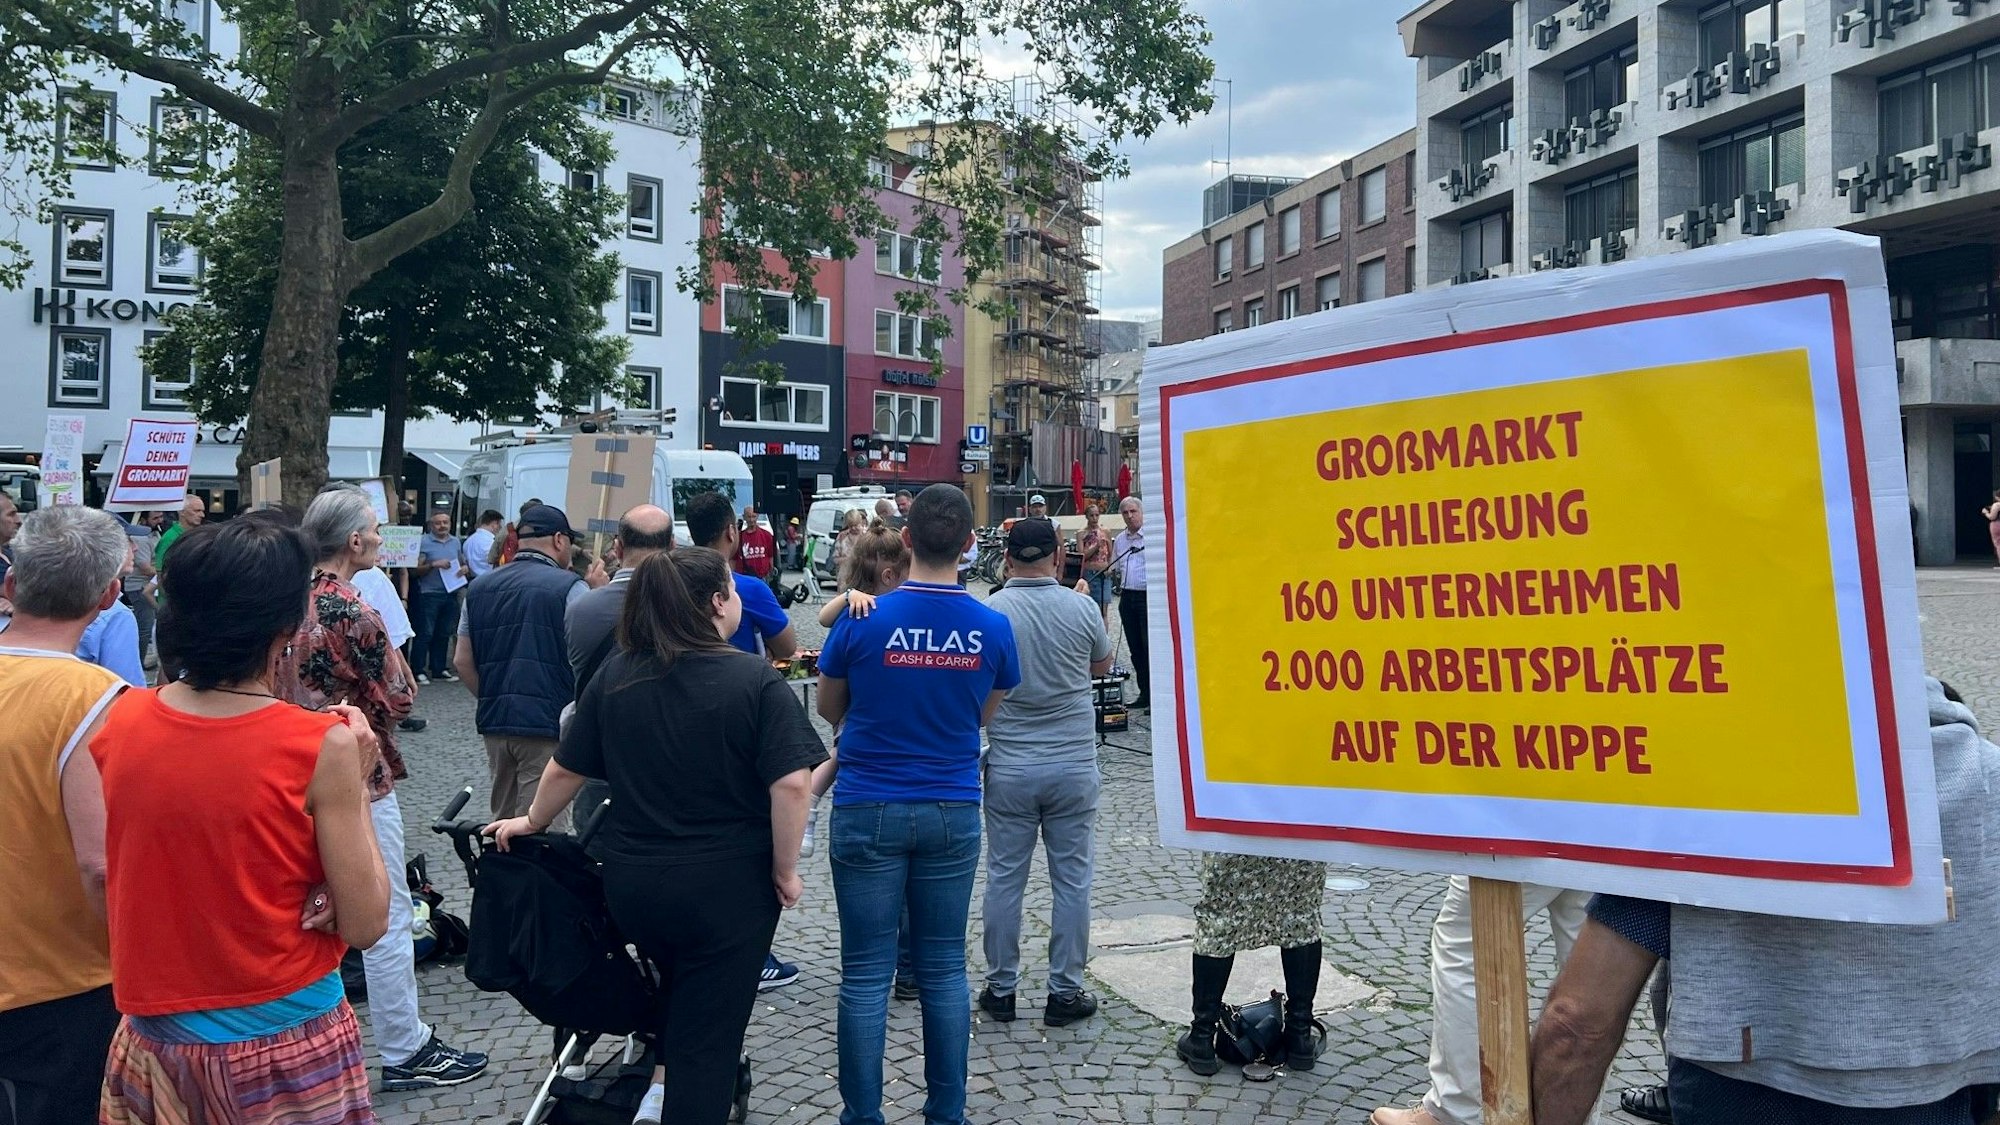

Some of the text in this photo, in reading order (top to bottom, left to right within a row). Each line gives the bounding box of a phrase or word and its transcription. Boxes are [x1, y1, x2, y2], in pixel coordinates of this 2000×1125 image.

[147, 430, 186, 444] SCHÜTZE
[853, 438, 866, 448] sky
[970, 427, 984, 443] U
[739, 441, 766, 458] HAUS
[1316, 411, 1583, 481] GROßMARKT
[146, 451, 179, 462] DEINEN
[127, 469, 187, 482] GROßMARKT
[1336, 489, 1589, 550] SCHLIEßUNG
[1280, 563, 1681, 622] 160 UNTERNEHMEN
[885, 627, 983, 654] ATLAS
[890, 654, 976, 667] CASH & CARRY
[1262, 637, 1729, 693] 2.000 ARBEITSPLÄTZE
[1330, 720, 1652, 774] AUF DER KIPPE
